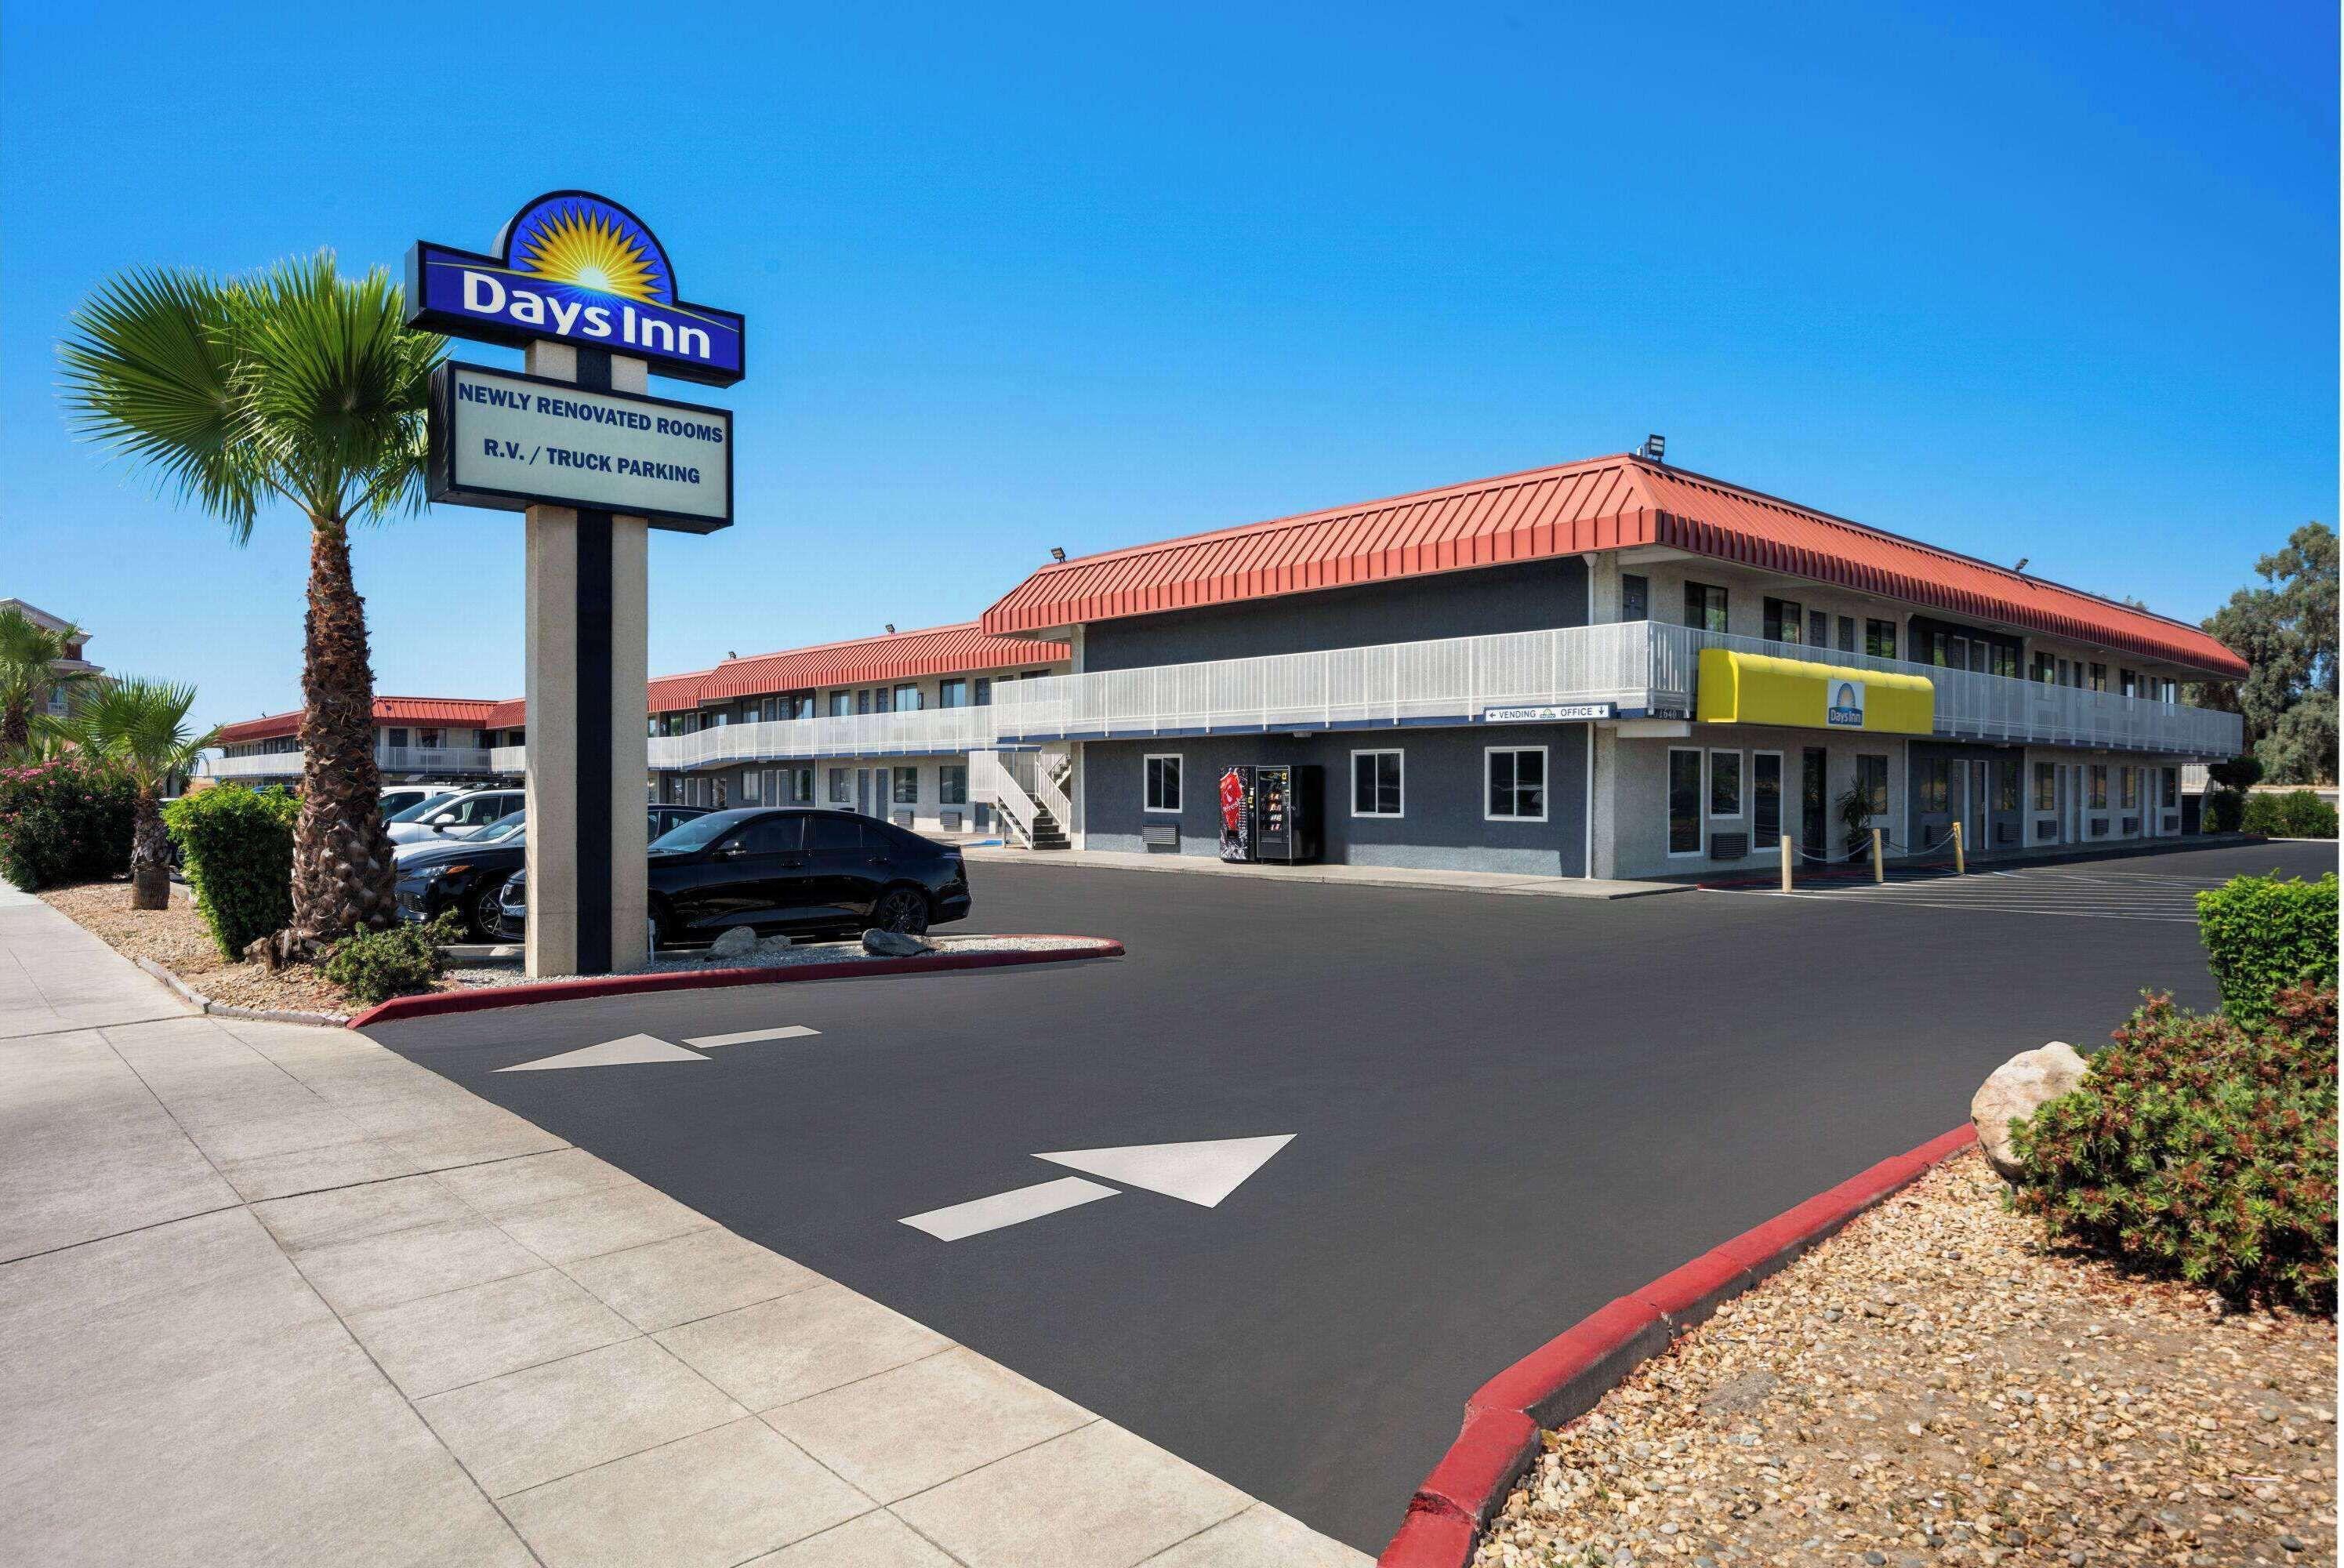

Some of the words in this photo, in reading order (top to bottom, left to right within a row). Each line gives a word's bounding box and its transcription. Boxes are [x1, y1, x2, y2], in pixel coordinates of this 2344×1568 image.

[463, 270, 611, 336] Days
[623, 307, 710, 359] Inn
[459, 383, 532, 411] NEWLY
[537, 396, 651, 430] RENOVATED
[657, 417, 723, 443] ROOMS
[484, 438, 524, 460] R.V.
[546, 447, 612, 473] TRUCK
[617, 457, 700, 484] PARKING
[1498, 710, 1537, 719] VENDING
[1560, 707, 1593, 717] OFFICE
[1831, 709, 1849, 723] Days
[1849, 710, 1861, 723] Inn
